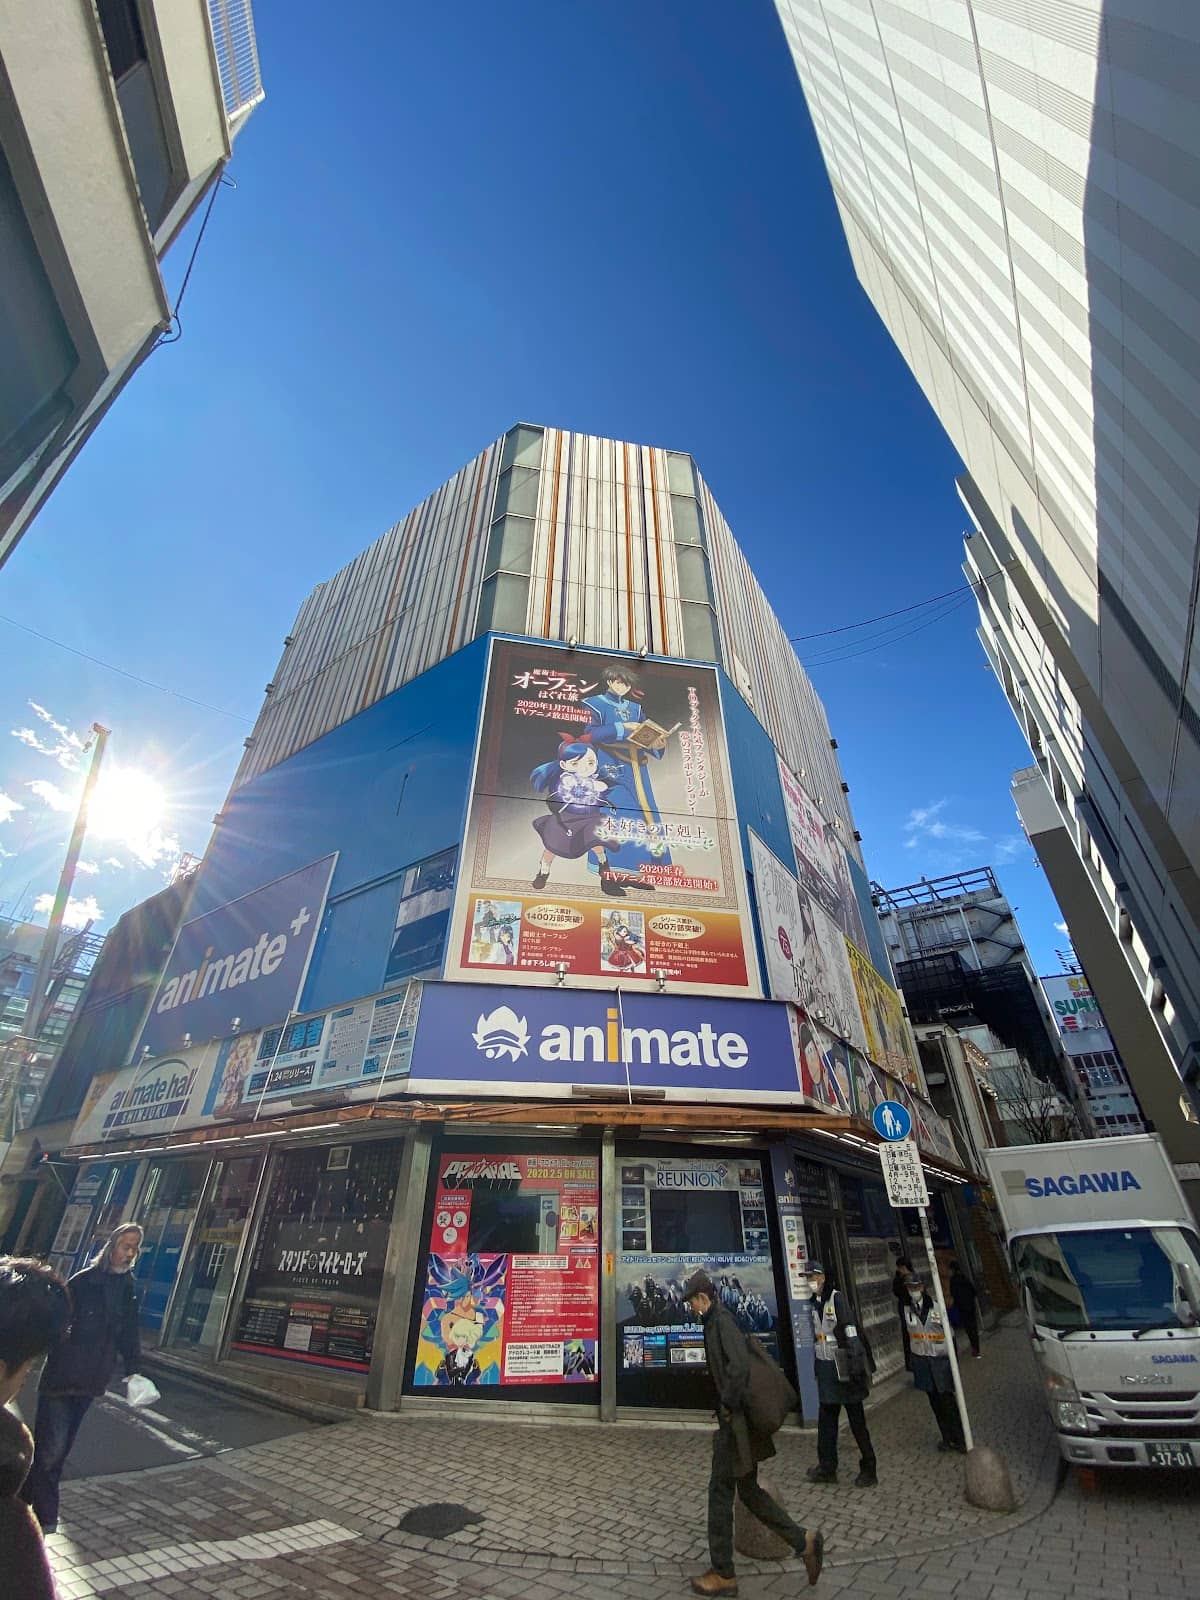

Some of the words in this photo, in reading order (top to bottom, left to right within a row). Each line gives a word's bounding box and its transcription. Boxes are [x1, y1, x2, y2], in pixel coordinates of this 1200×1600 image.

[512, 671, 599, 694] オーフェン
[538, 690, 580, 702] はぐれ旅
[604, 817, 707, 839] 本好きの下剋上
[539, 1008, 749, 1068] animate
[656, 1172, 722, 1187] REUNION
[1024, 1170, 1142, 1198] SAGAWA
[1151, 1353, 1198, 1364] SAGAWA
[1157, 1452, 1193, 1466] 37-01
